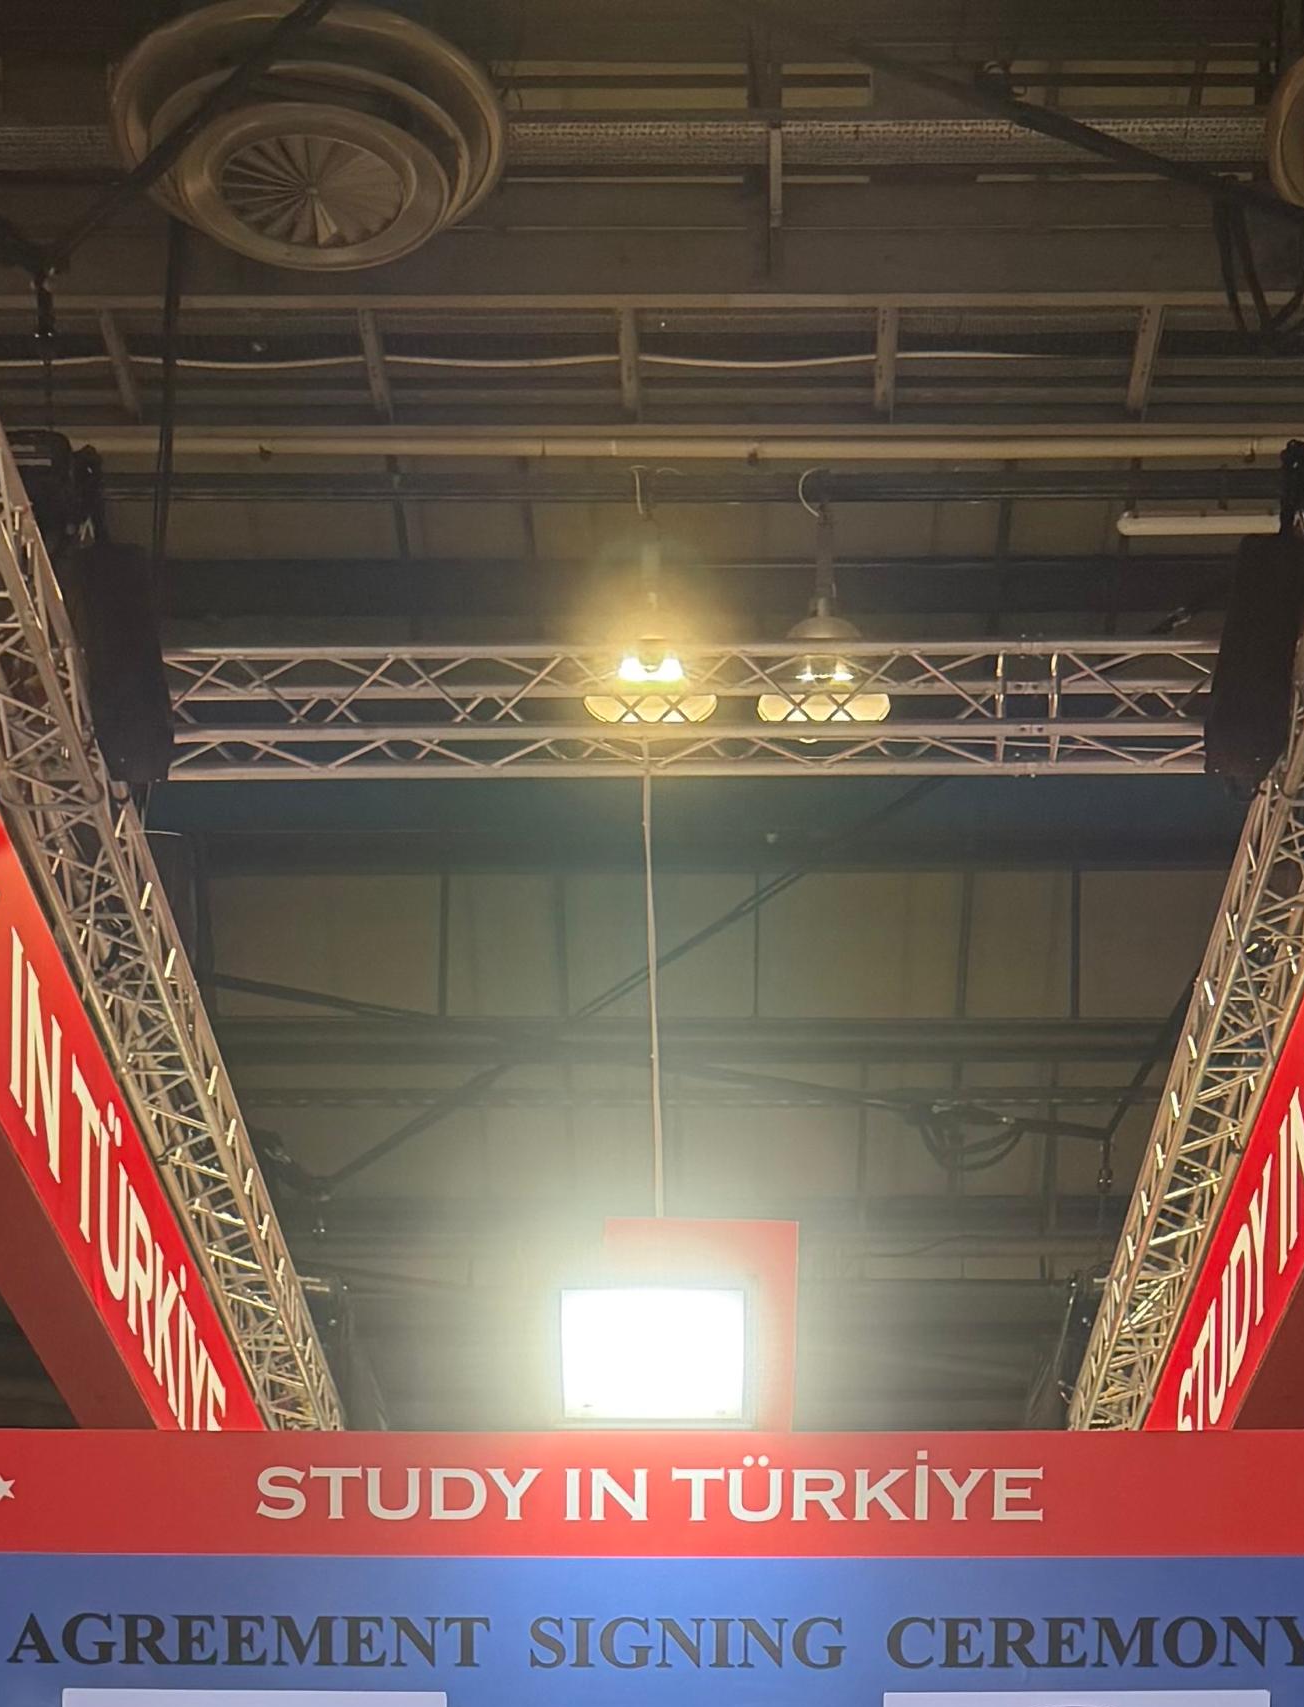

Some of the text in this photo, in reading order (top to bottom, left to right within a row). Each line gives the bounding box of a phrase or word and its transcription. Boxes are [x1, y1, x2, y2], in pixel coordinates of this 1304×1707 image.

[9, 926, 64, 1184] IN
[255, 1449, 1044, 1523] STUDY IN TÜRKİYE
[7, 1613, 490, 1668] AGREEMENT
[528, 1614, 845, 1670] SIGNING
